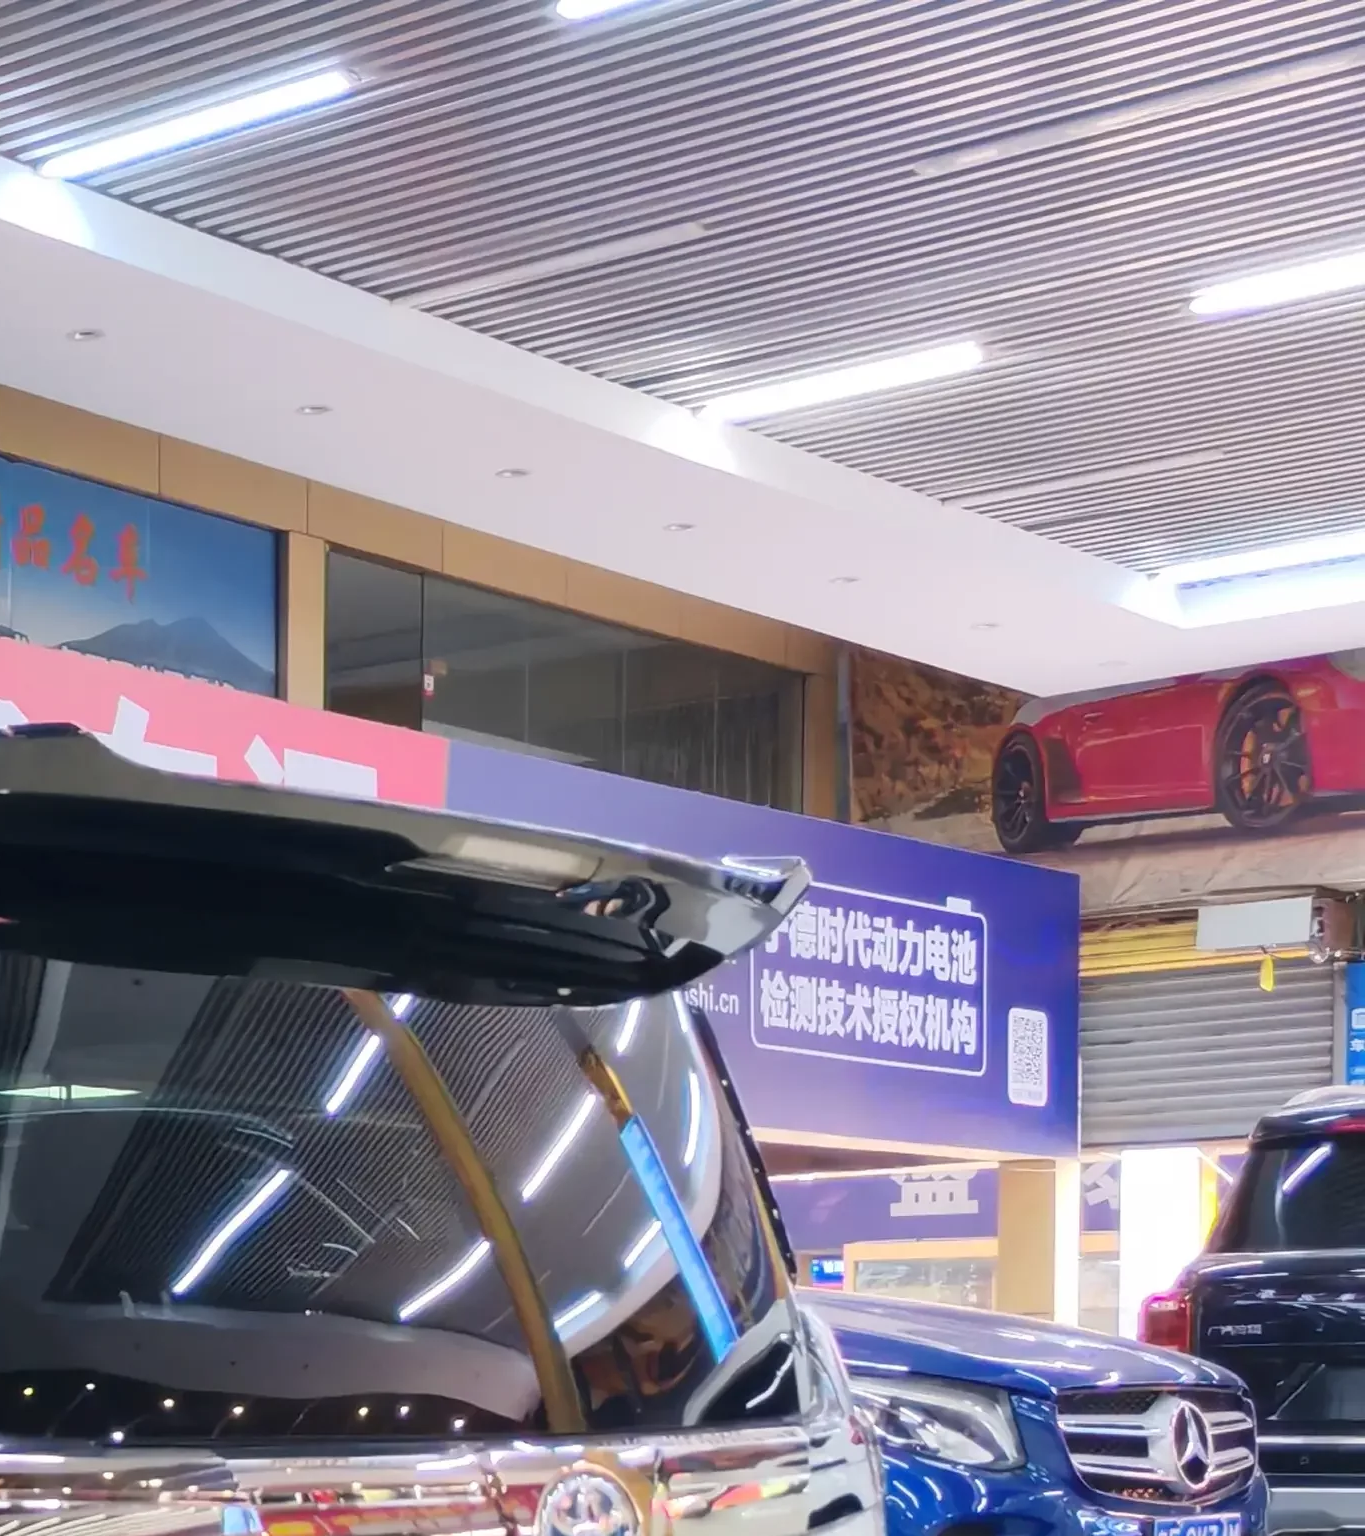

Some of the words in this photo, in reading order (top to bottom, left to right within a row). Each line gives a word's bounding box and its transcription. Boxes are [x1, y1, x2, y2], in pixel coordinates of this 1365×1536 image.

[760, 970, 978, 1056] 检测技术授权机构
